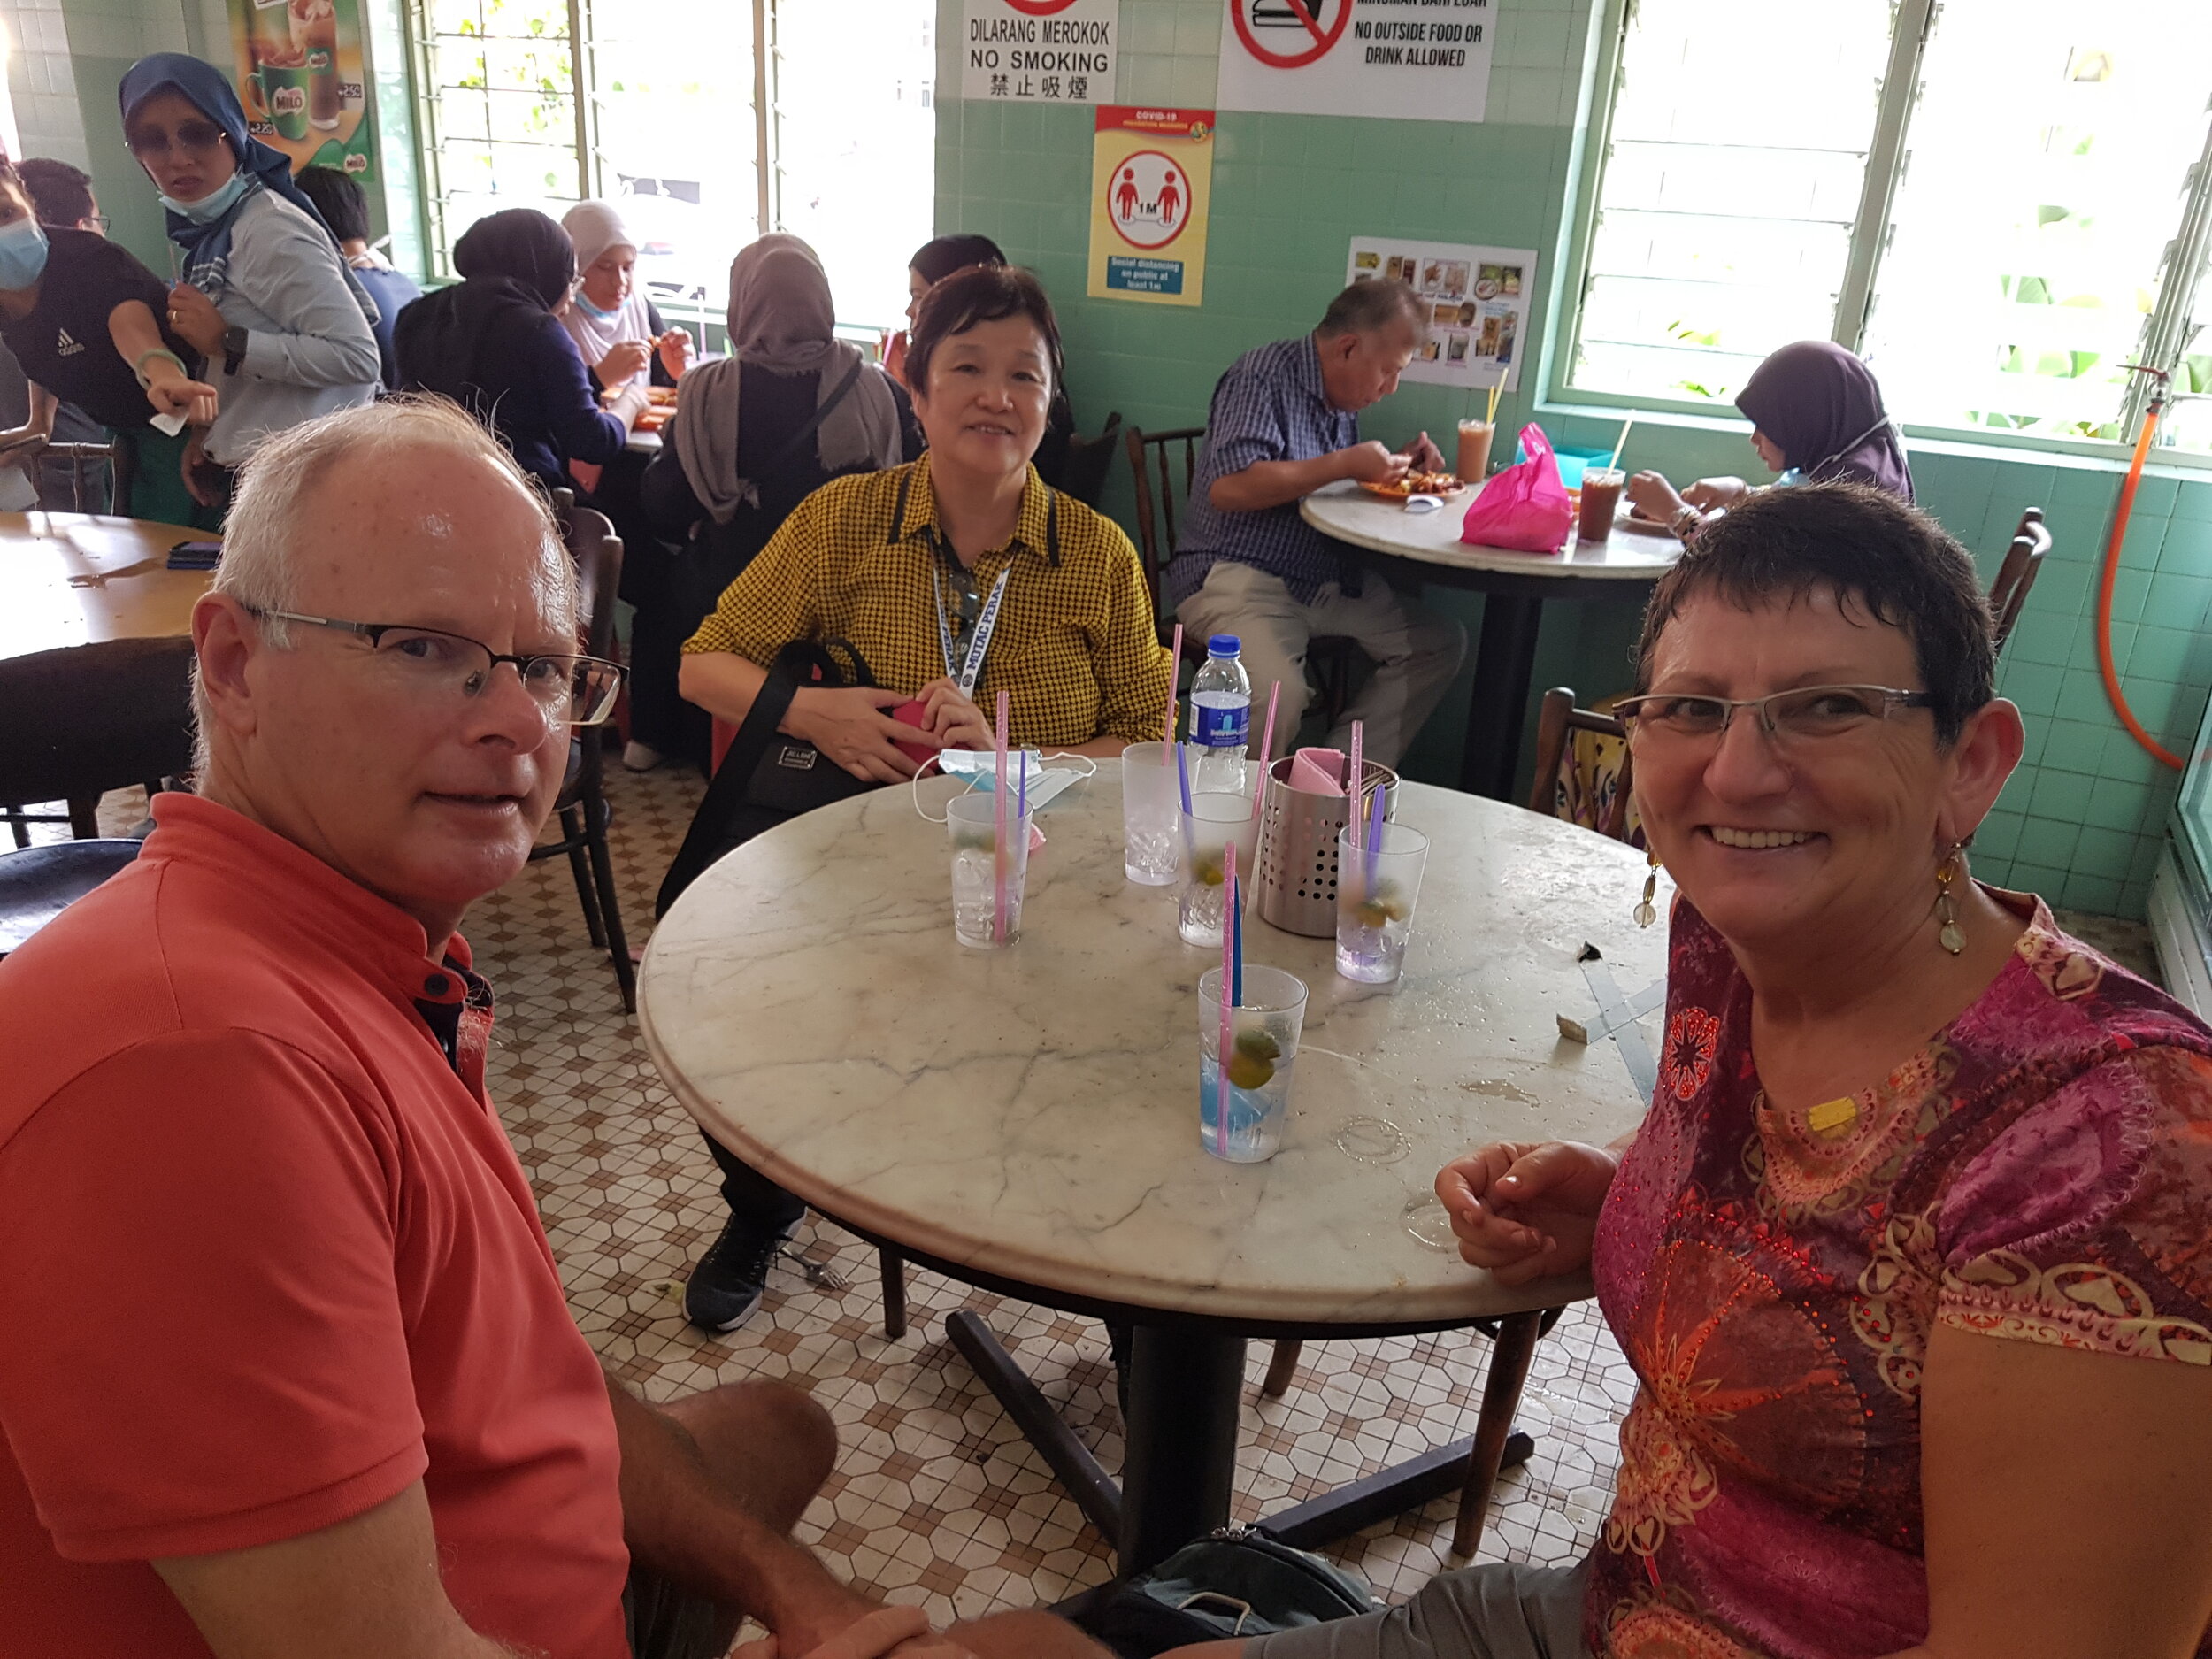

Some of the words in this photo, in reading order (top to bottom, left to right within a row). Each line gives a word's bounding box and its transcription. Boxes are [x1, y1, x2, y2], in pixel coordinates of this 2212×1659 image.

[971, 19, 1036, 43] DILARANG
[1041, 20, 1110, 45] MEROKOK
[1355, 21, 1371, 39] NO
[1375, 21, 1426, 41] OUTSIDE
[1429, 24, 1463, 42] FOOD
[1465, 25, 1483, 42] OR
[971, 50, 999, 68] NO
[1010, 50, 1108, 73] SMOKING
[1365, 46, 1403, 65] DRINK
[1406, 48, 1466, 66] ALLOWED
[990, 73, 1087, 99] 禁止吸煙
[276, 96, 303, 110] MILO
[967, 625, 989, 670] MOTAC
[983, 581, 1003, 625] PERAK
